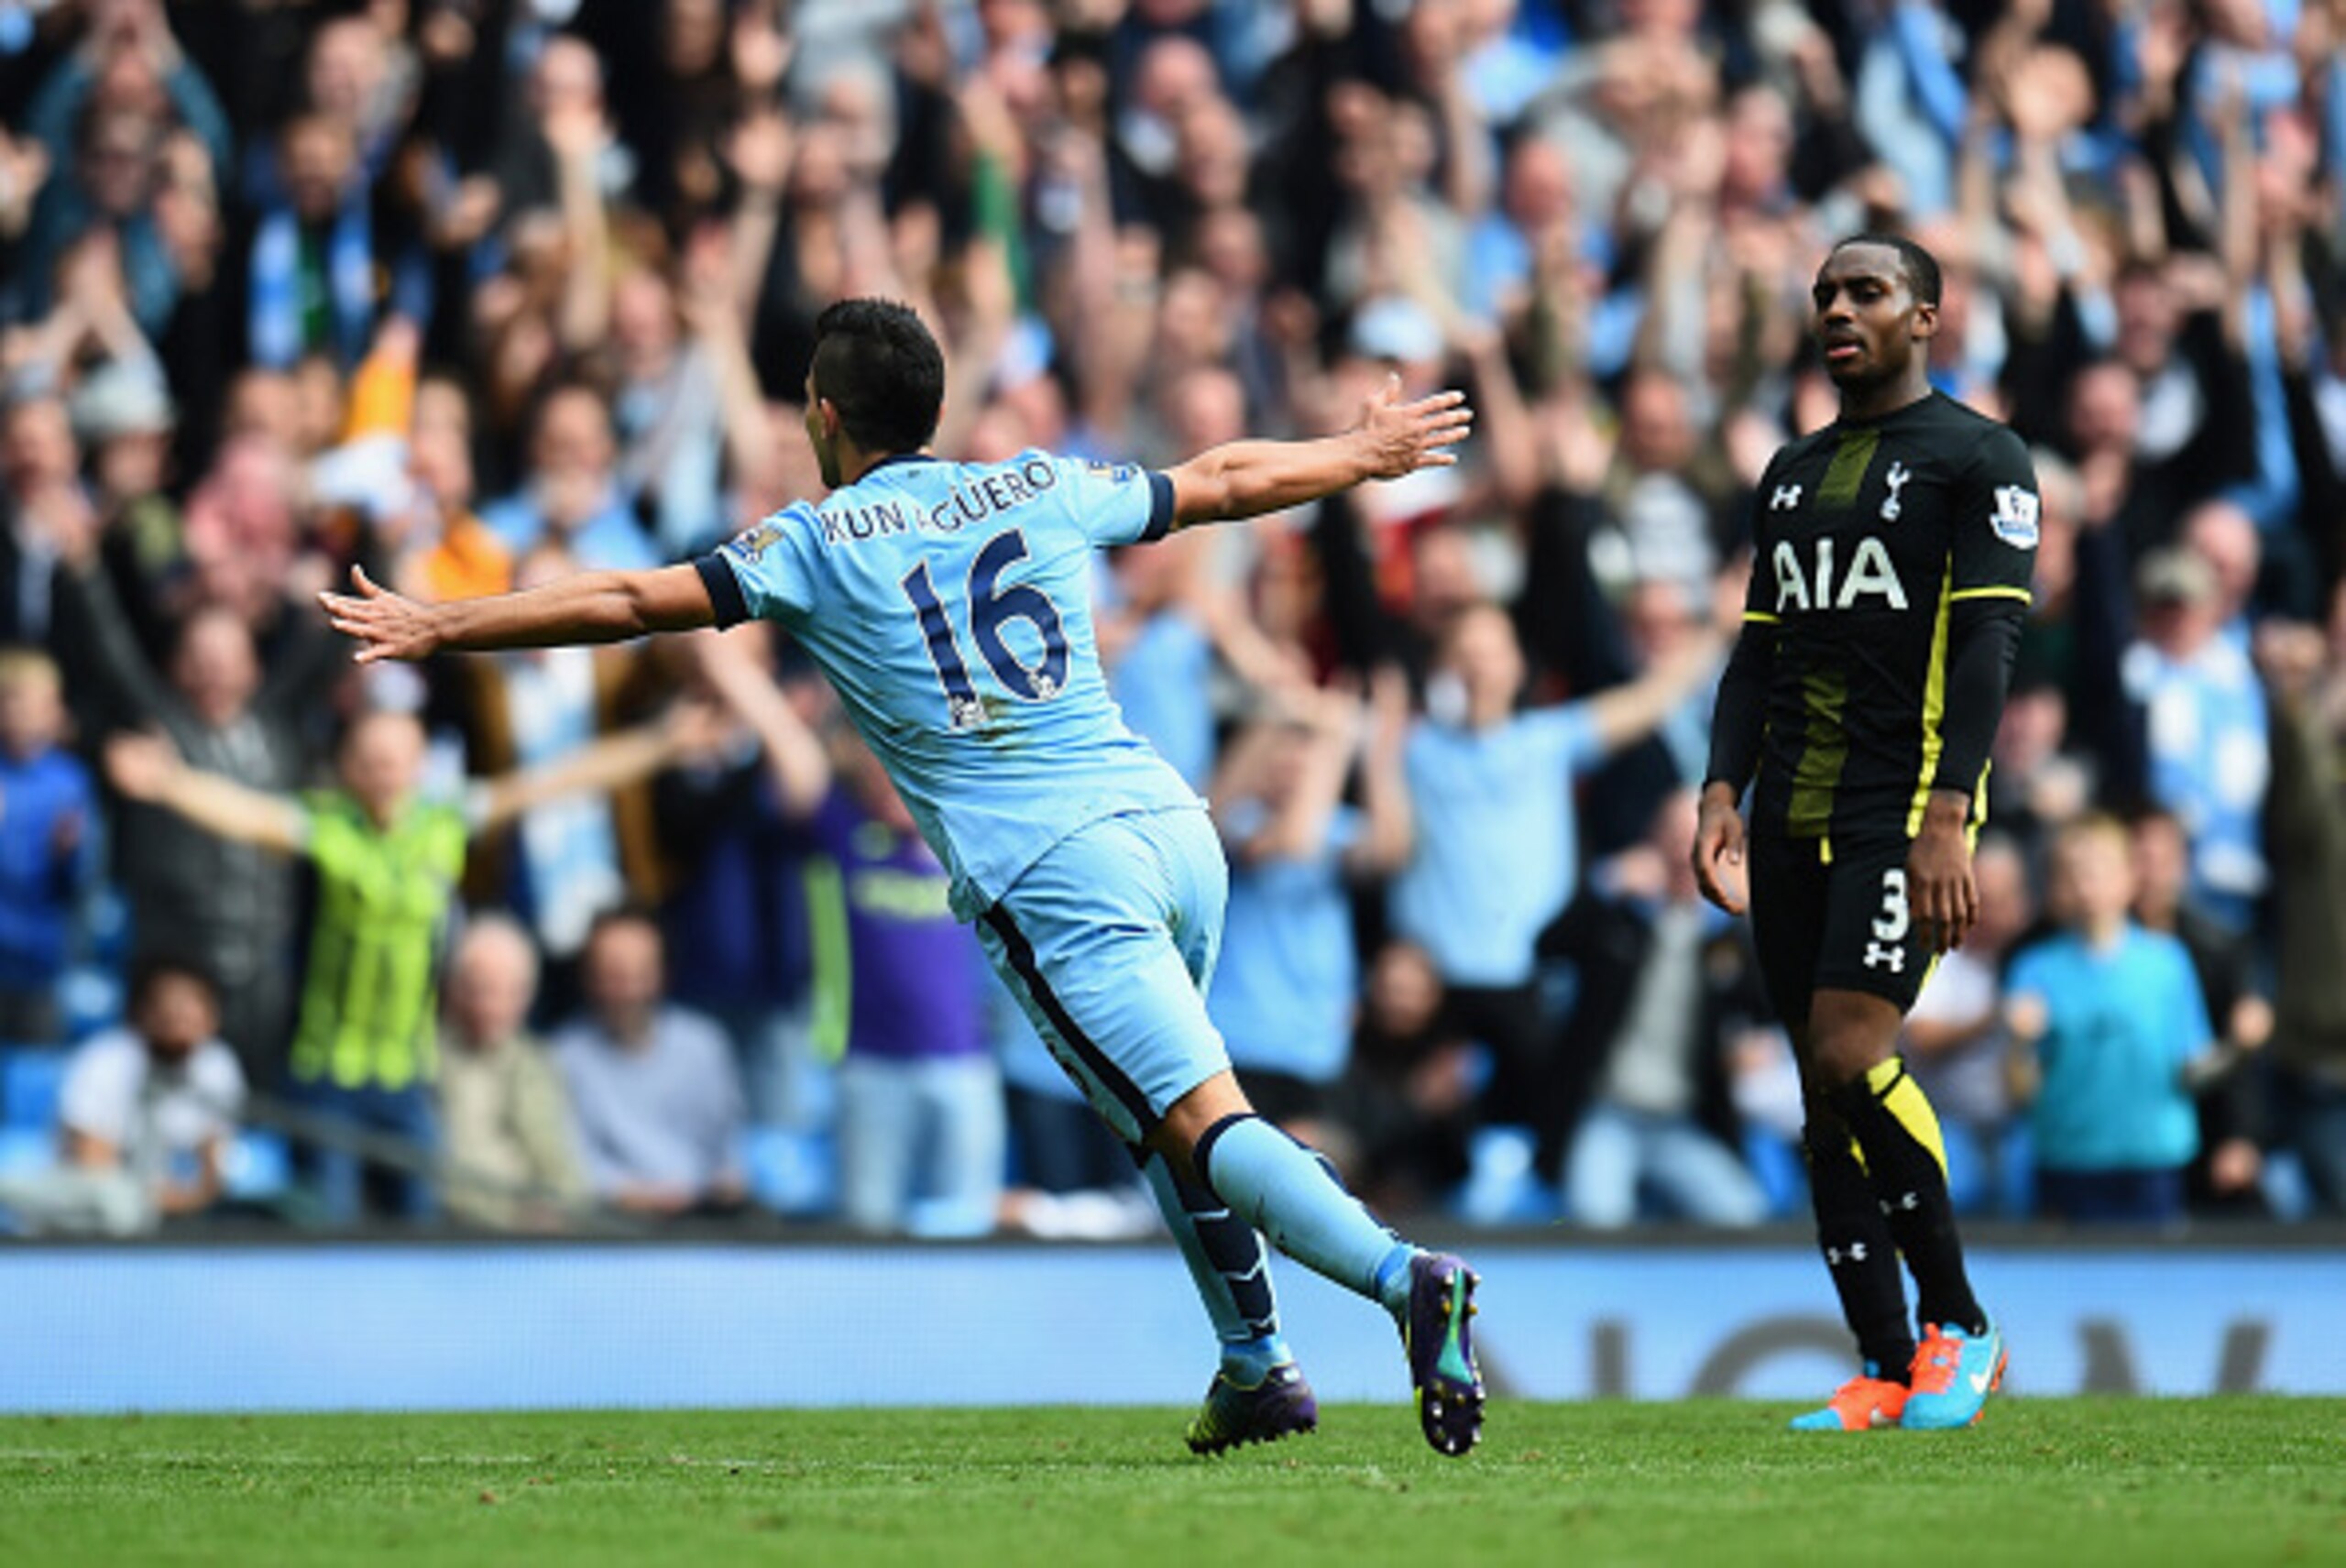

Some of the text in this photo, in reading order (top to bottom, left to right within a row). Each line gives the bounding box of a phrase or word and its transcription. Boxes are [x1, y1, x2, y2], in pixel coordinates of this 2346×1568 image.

[823, 502, 905, 543] KUN
[1772, 538, 1908, 612] AIA
[902, 530, 1069, 729] 16
[1872, 869, 1910, 941] 3
